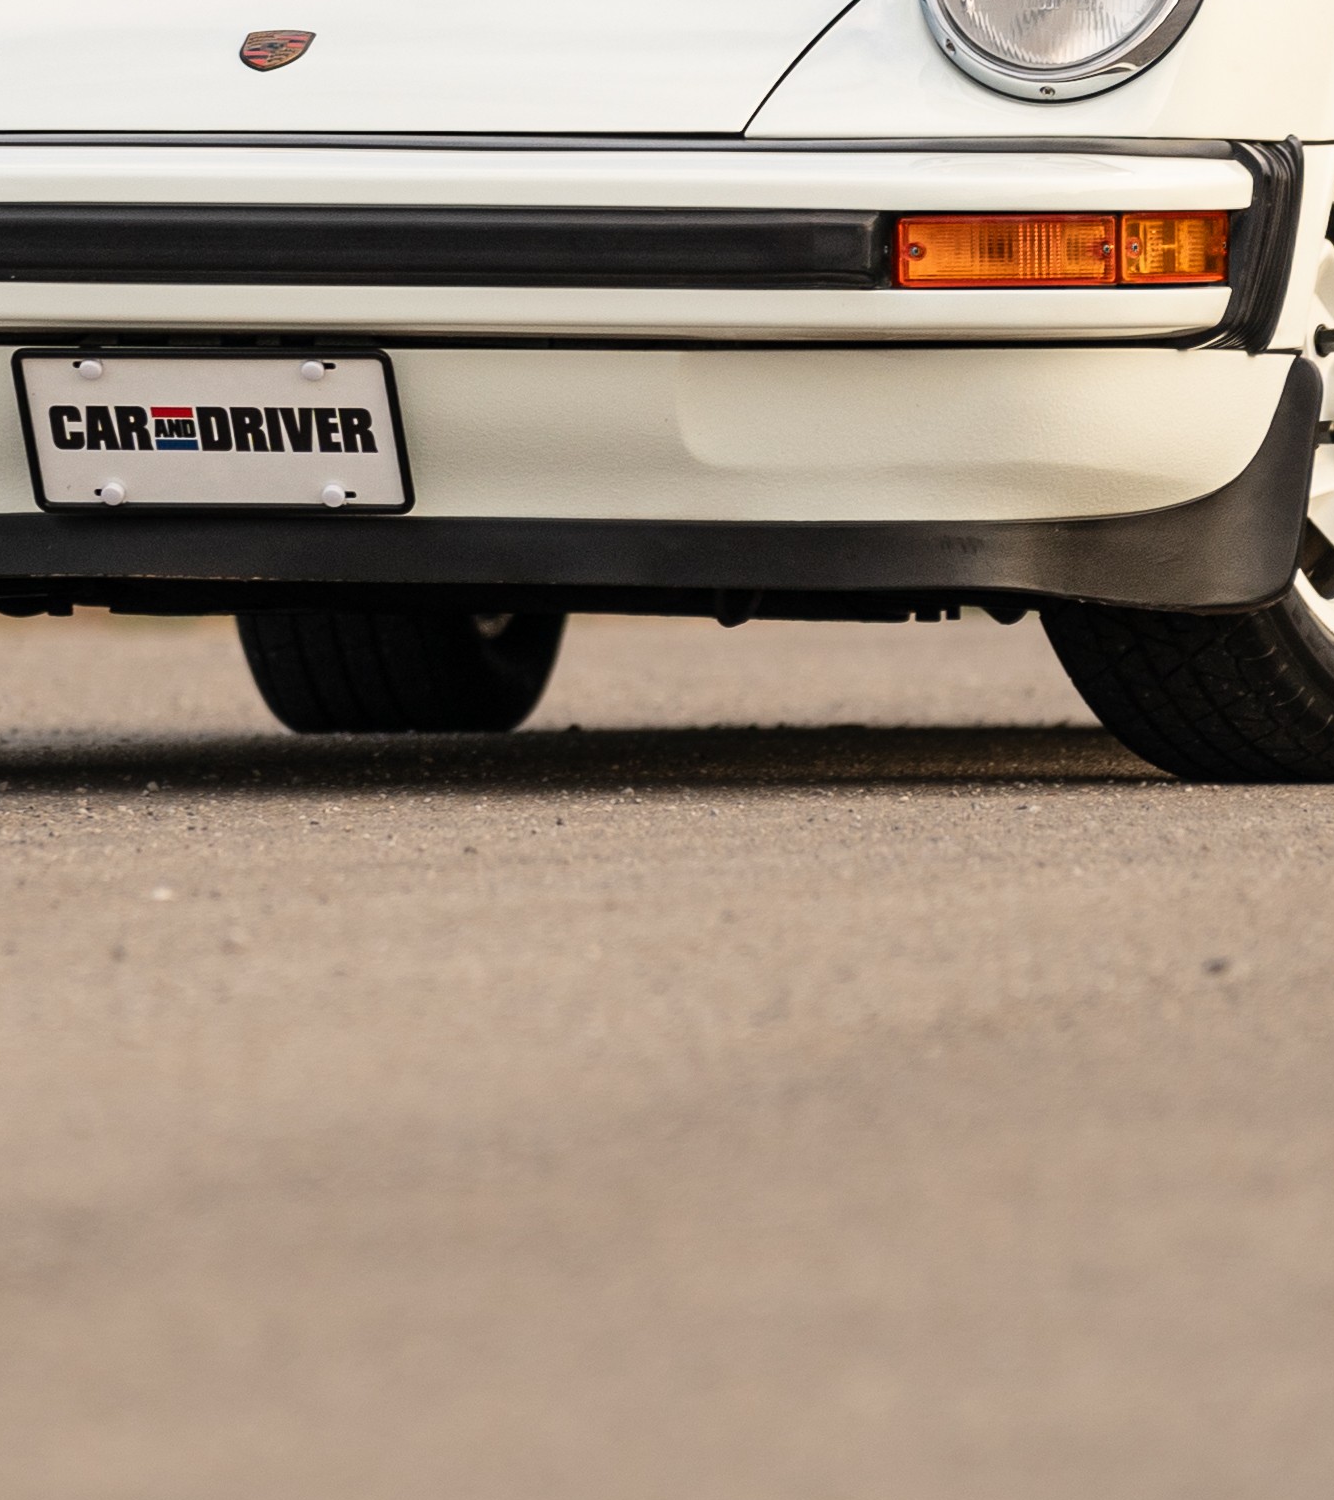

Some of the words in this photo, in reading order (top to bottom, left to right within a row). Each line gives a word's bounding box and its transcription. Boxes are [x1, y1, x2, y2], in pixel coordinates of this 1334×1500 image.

[48, 404, 154, 451] CAR
[154, 418, 197, 439] AND
[195, 406, 379, 453] DRIVER
